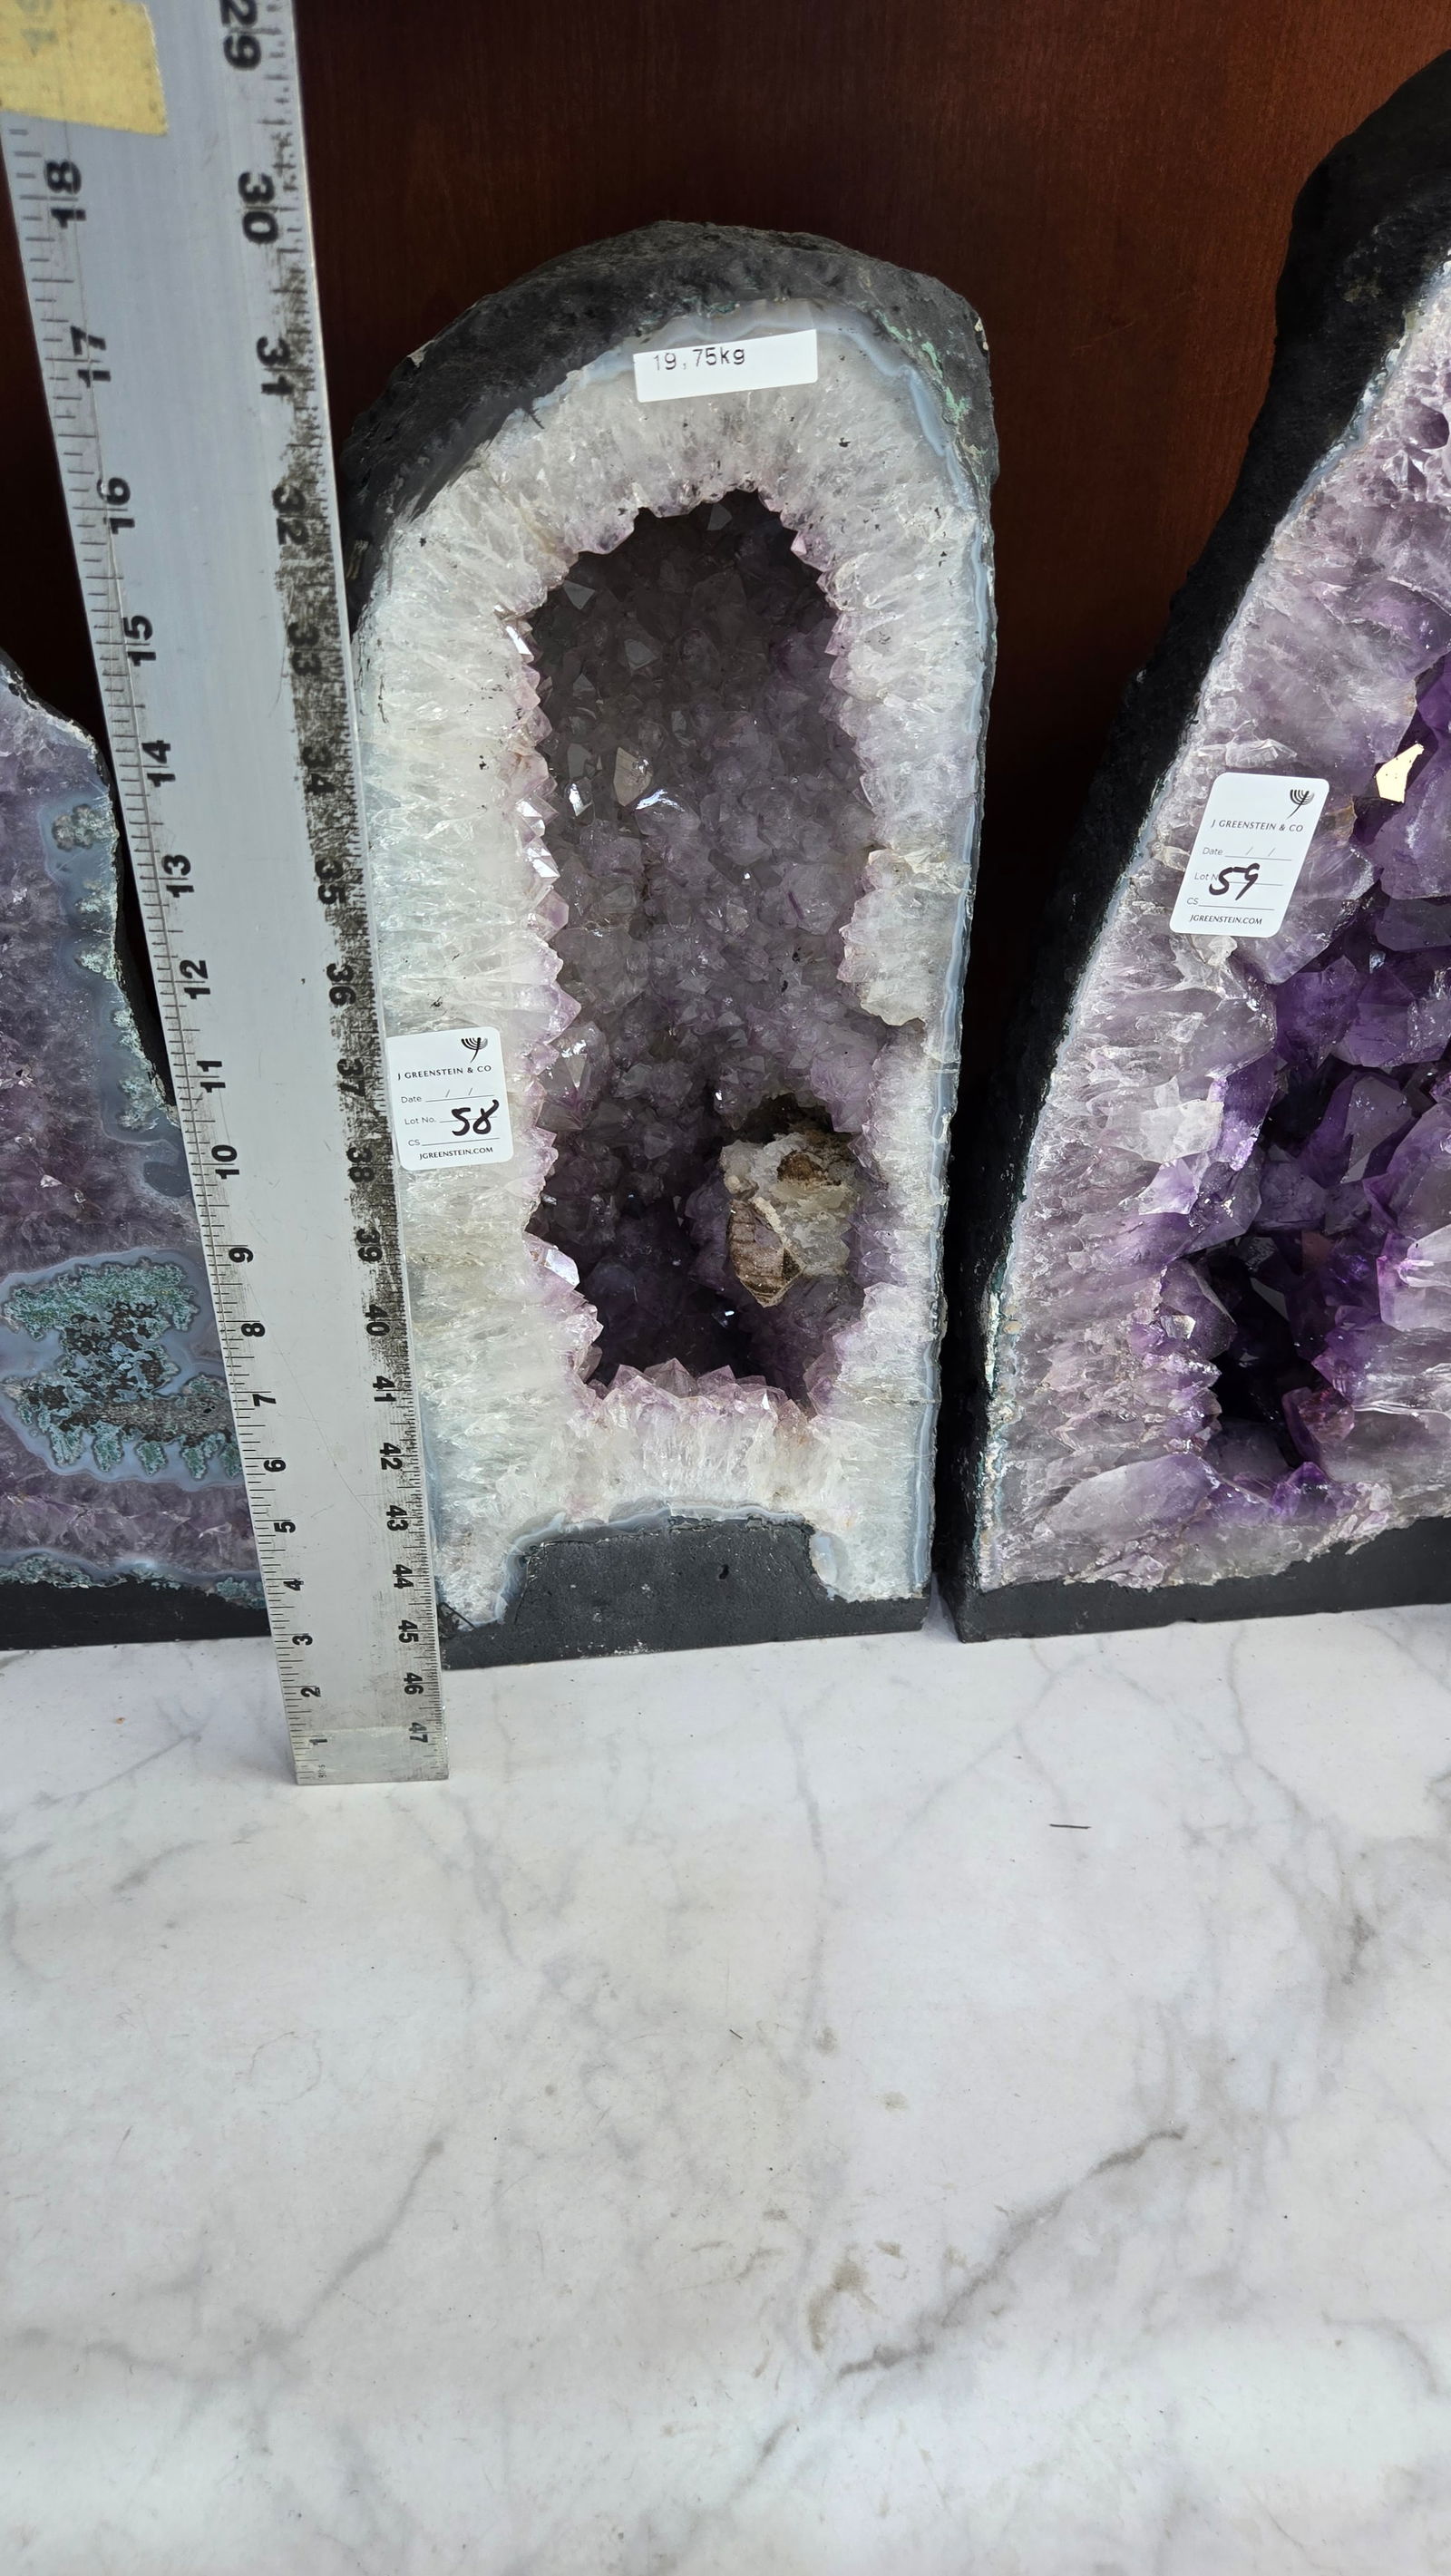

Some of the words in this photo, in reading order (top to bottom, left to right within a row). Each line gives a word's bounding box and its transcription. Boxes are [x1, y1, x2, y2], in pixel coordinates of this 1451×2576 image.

[220, 0, 262, 71] 29
[44, 160, 86, 228] 18
[238, 171, 278, 244] 30
[70, 326, 111, 387] 17
[256, 335, 292, 396] 31
[97, 477, 134, 534] 16
[272, 485, 309, 545] 32
[124, 615, 156, 666] 15
[141, 740, 176, 788] 14
[1219, 820, 1276, 831] GREENSTEIN
[1279, 823, 1286, 831] &
[1289, 824, 1304, 832] CO
[1202, 847, 1223, 856] Date
[161, 854, 194, 899] 13
[314, 859, 346, 905] 35
[1194, 872, 1209, 880] Lot
[1208, 862, 1261, 901] 59
[1186, 897, 1199, 906] CS
[1189, 914, 1262, 925] JGREENSTEIN.COM
[180, 959, 209, 999] 12
[326, 963, 356, 1006] 36
[197, 1059, 225, 1093] 11
[336, 1058, 365, 1095] 37
[404, 1067, 463, 1079] GREENSTEIN
[477, 1064, 492, 1073] CO
[401, 1095, 422, 1103] Date
[404, 1117, 419, 1125] Lot
[422, 1115, 436, 1124] No.
[452, 1099, 500, 1136] 58
[408, 1139, 421, 1147] CS
[419, 1146, 493, 1161] JGREENSTEIN.COM
[211, 1144, 239, 1180] 10
[346, 1145, 373, 1182] 38
[229, 1248, 253, 1264] 9
[355, 1228, 382, 1262] 39
[240, 1322, 265, 1337] 8
[365, 1304, 390, 1336] 40
[252, 1394, 277, 1407] 7
[372, 1375, 396, 1403] 41
[263, 1458, 286, 1473] 6
[380, 1443, 403, 1470] 42
[274, 1520, 296, 1533] 5
[385, 1504, 408, 1531] 43
[283, 1579, 303, 1591] 4
[393, 1563, 414, 1589] 44
[292, 1635, 313, 1646] 3
[398, 1619, 419, 1644] 45
[301, 1687, 321, 1697] 2
[403, 1672, 424, 1695] 46
[408, 1723, 429, 1743] 47
